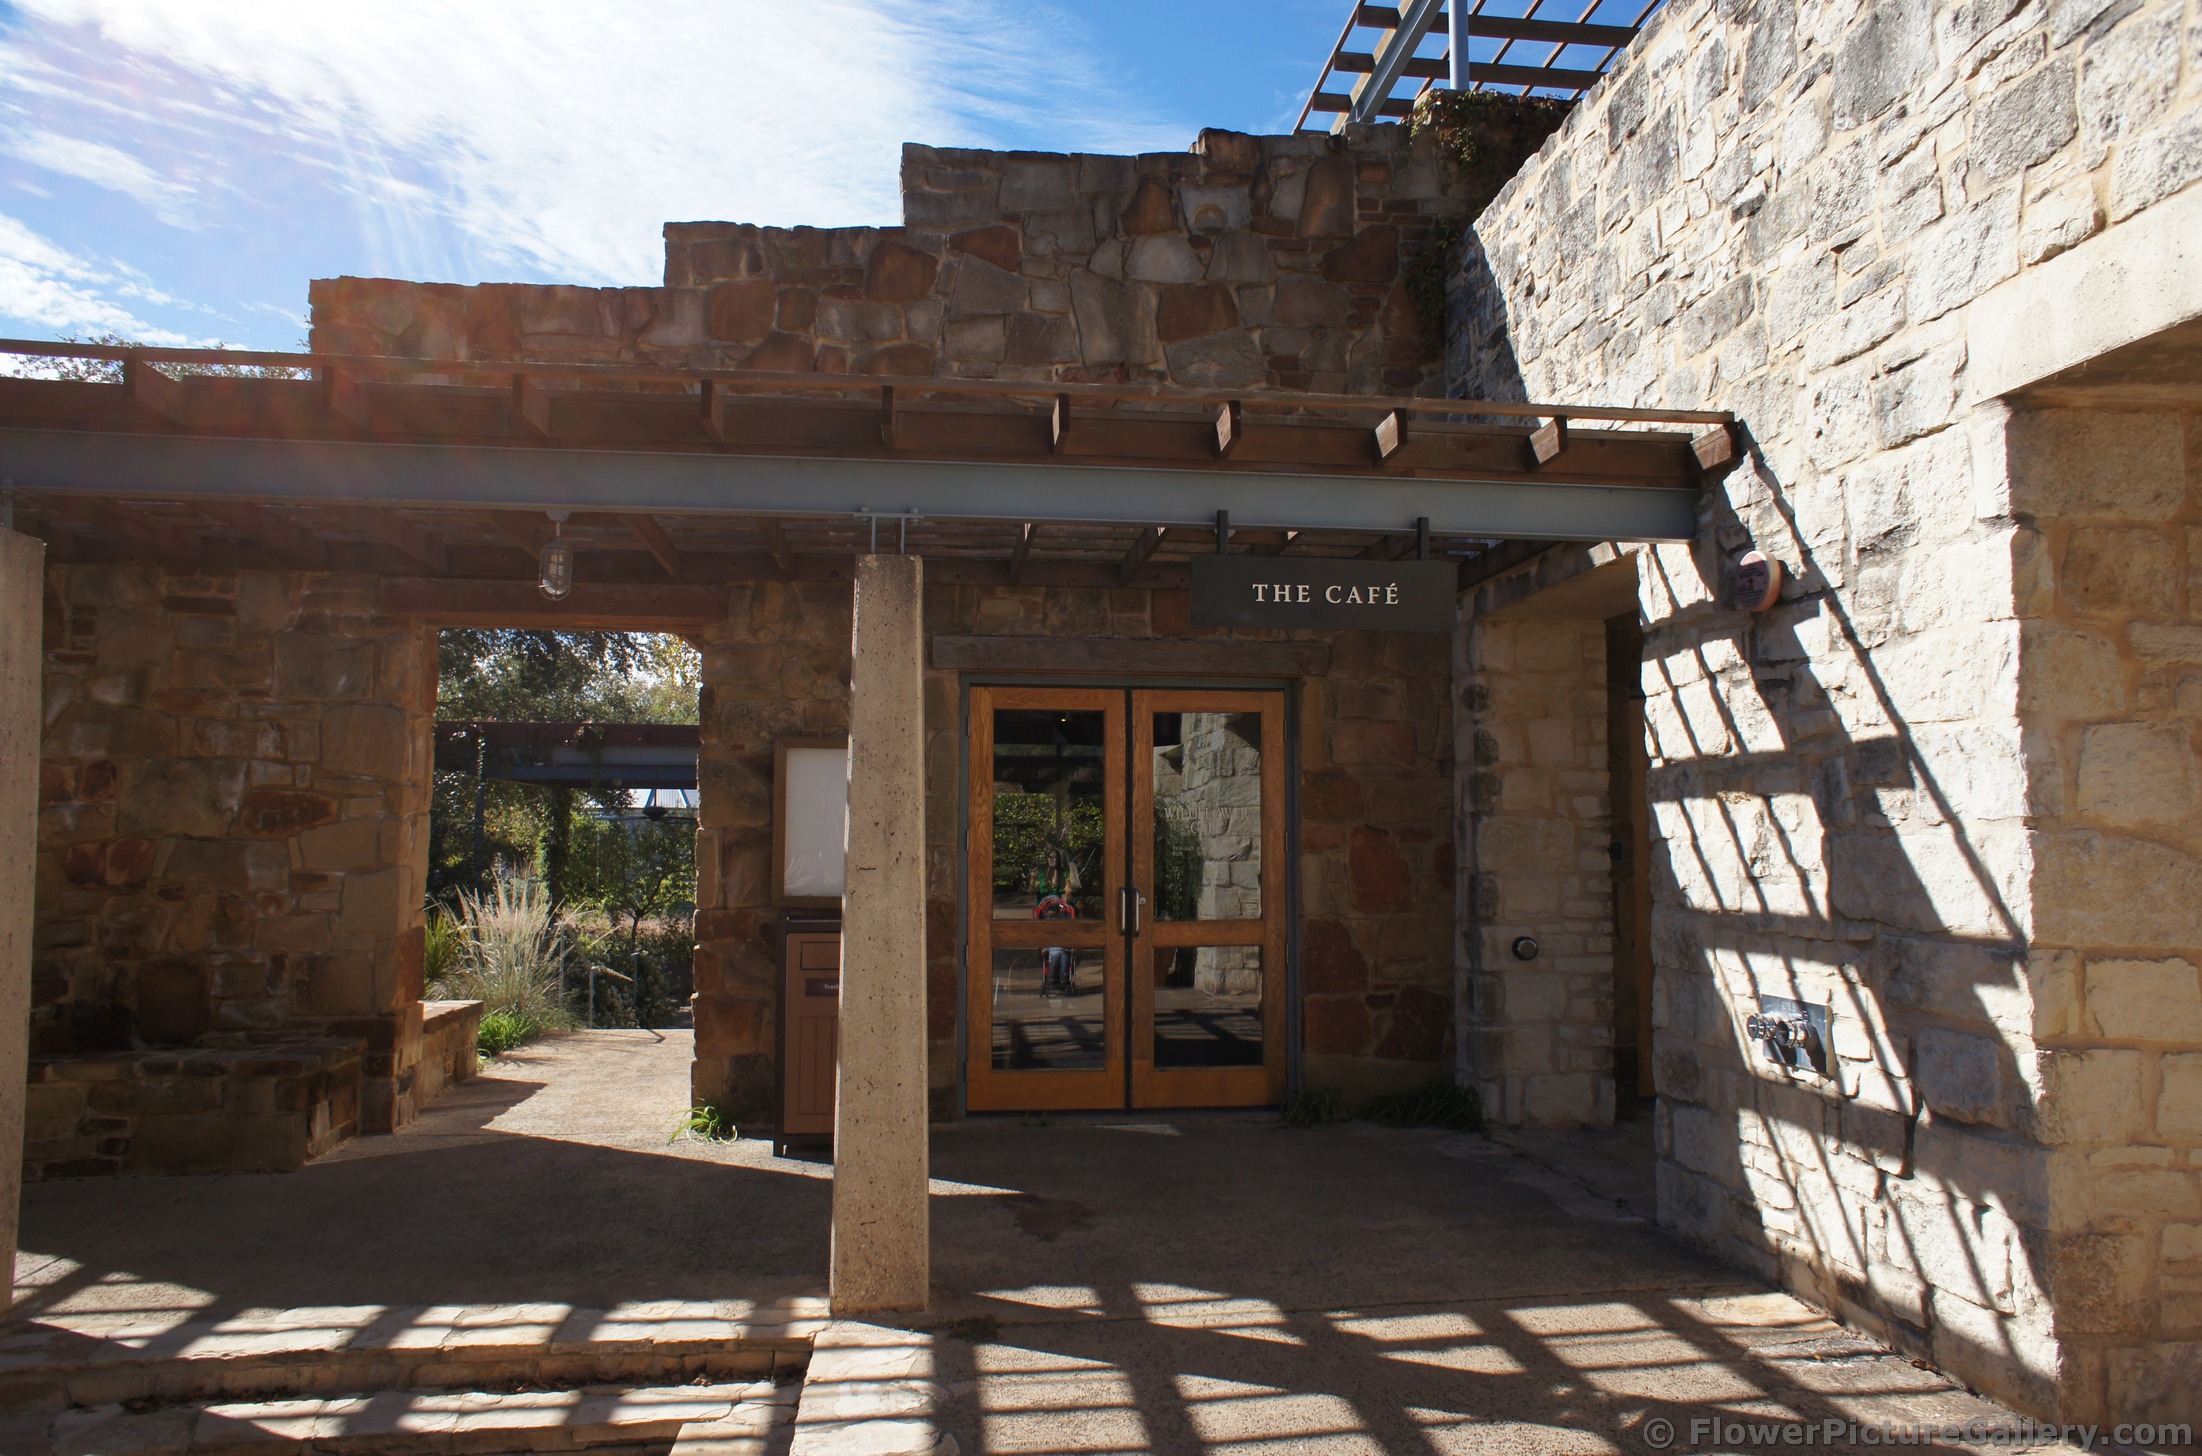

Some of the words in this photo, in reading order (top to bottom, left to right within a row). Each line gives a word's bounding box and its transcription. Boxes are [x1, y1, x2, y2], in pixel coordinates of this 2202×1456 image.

[1252, 583, 1310, 603] THE
[1325, 582, 1399, 605] CAFÉ
[1164, 807, 1249, 820] WILDFLOWR
